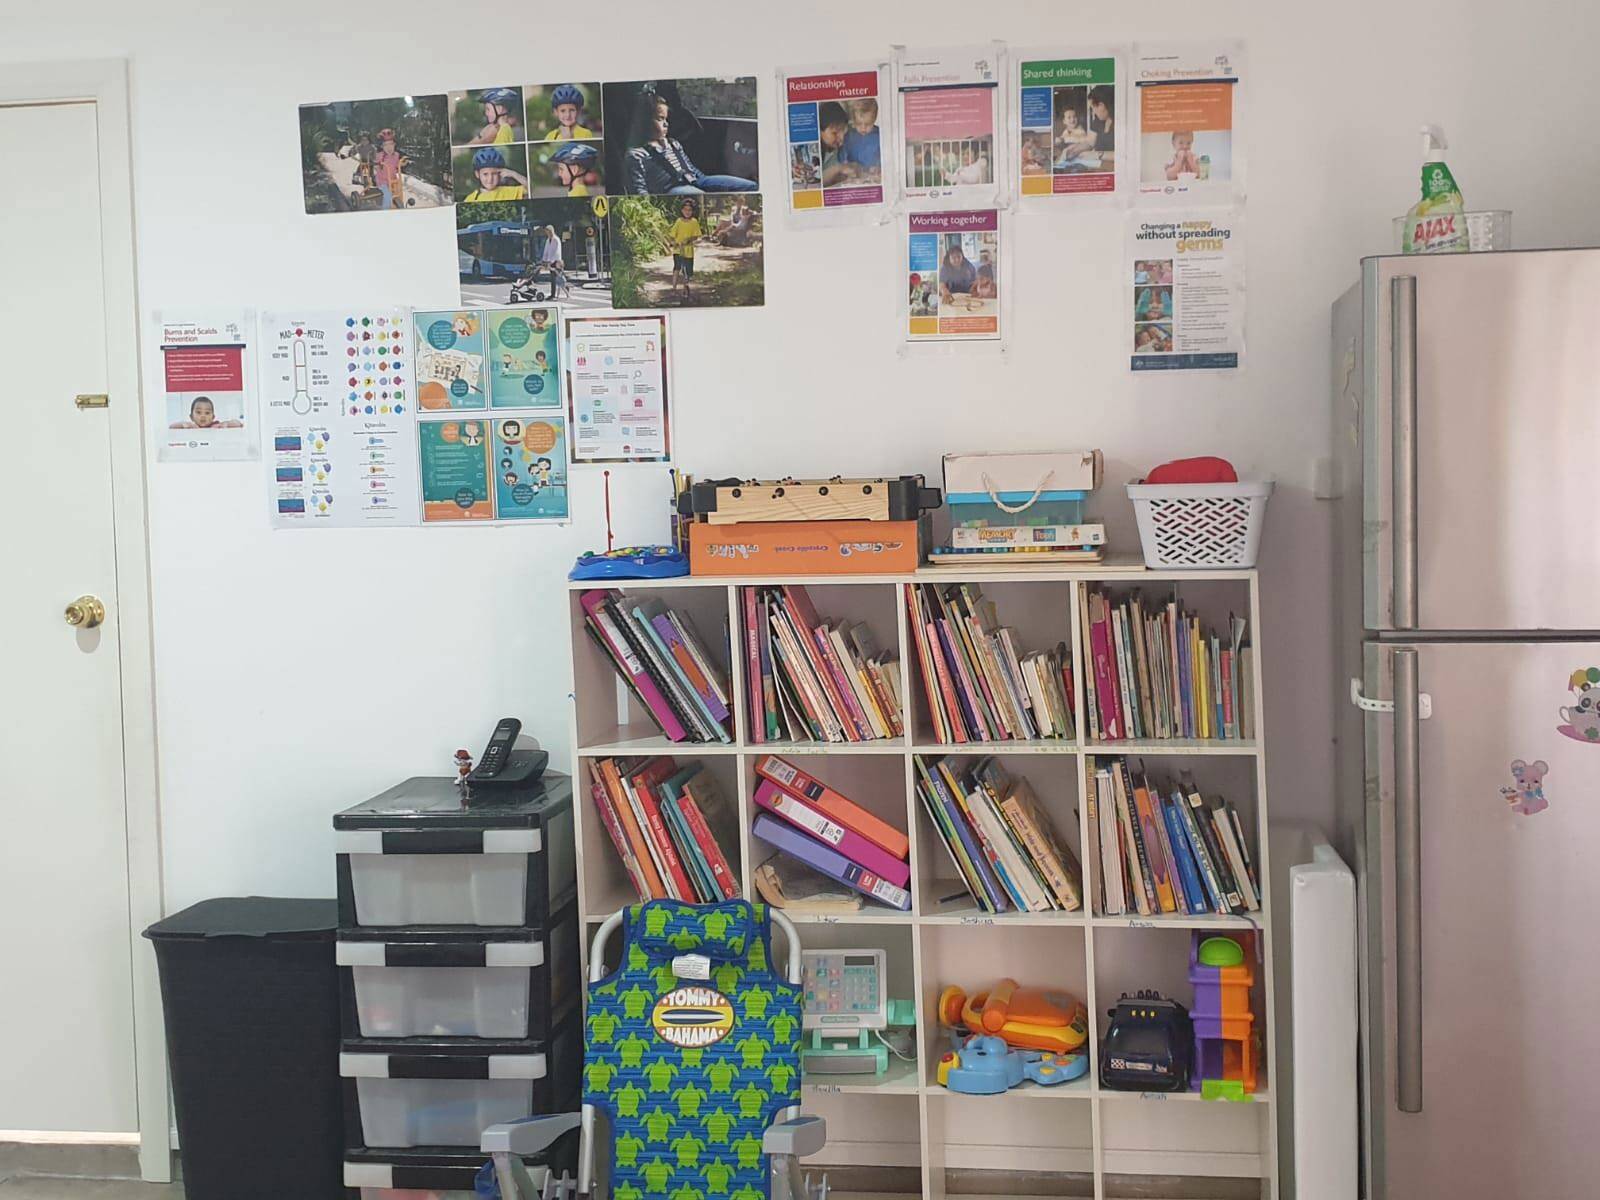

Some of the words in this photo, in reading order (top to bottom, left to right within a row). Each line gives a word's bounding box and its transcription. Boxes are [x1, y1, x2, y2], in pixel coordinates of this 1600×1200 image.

[1023, 68, 1054, 79] Shared
[1056, 67, 1092, 78] thinking
[789, 79, 846, 91] Relationships
[839, 87, 869, 96] matter
[911, 216, 949, 227] Working
[950, 214, 987, 226] together
[1140, 222, 1175, 231] Changing
[1182, 220, 1212, 230] nappy
[1413, 213, 1456, 243] AJAX
[1135, 230, 1176, 240] without
[1178, 228, 1231, 241] spreading
[1176, 238, 1224, 253] germs
[164, 328, 182, 336] Burns
[184, 327, 196, 335] and
[197, 327, 218, 335] Scalds
[307, 329, 325, 340] METER
[668, 987, 720, 1007] TOMMY
[665, 1026, 719, 1045] BAHAMA
